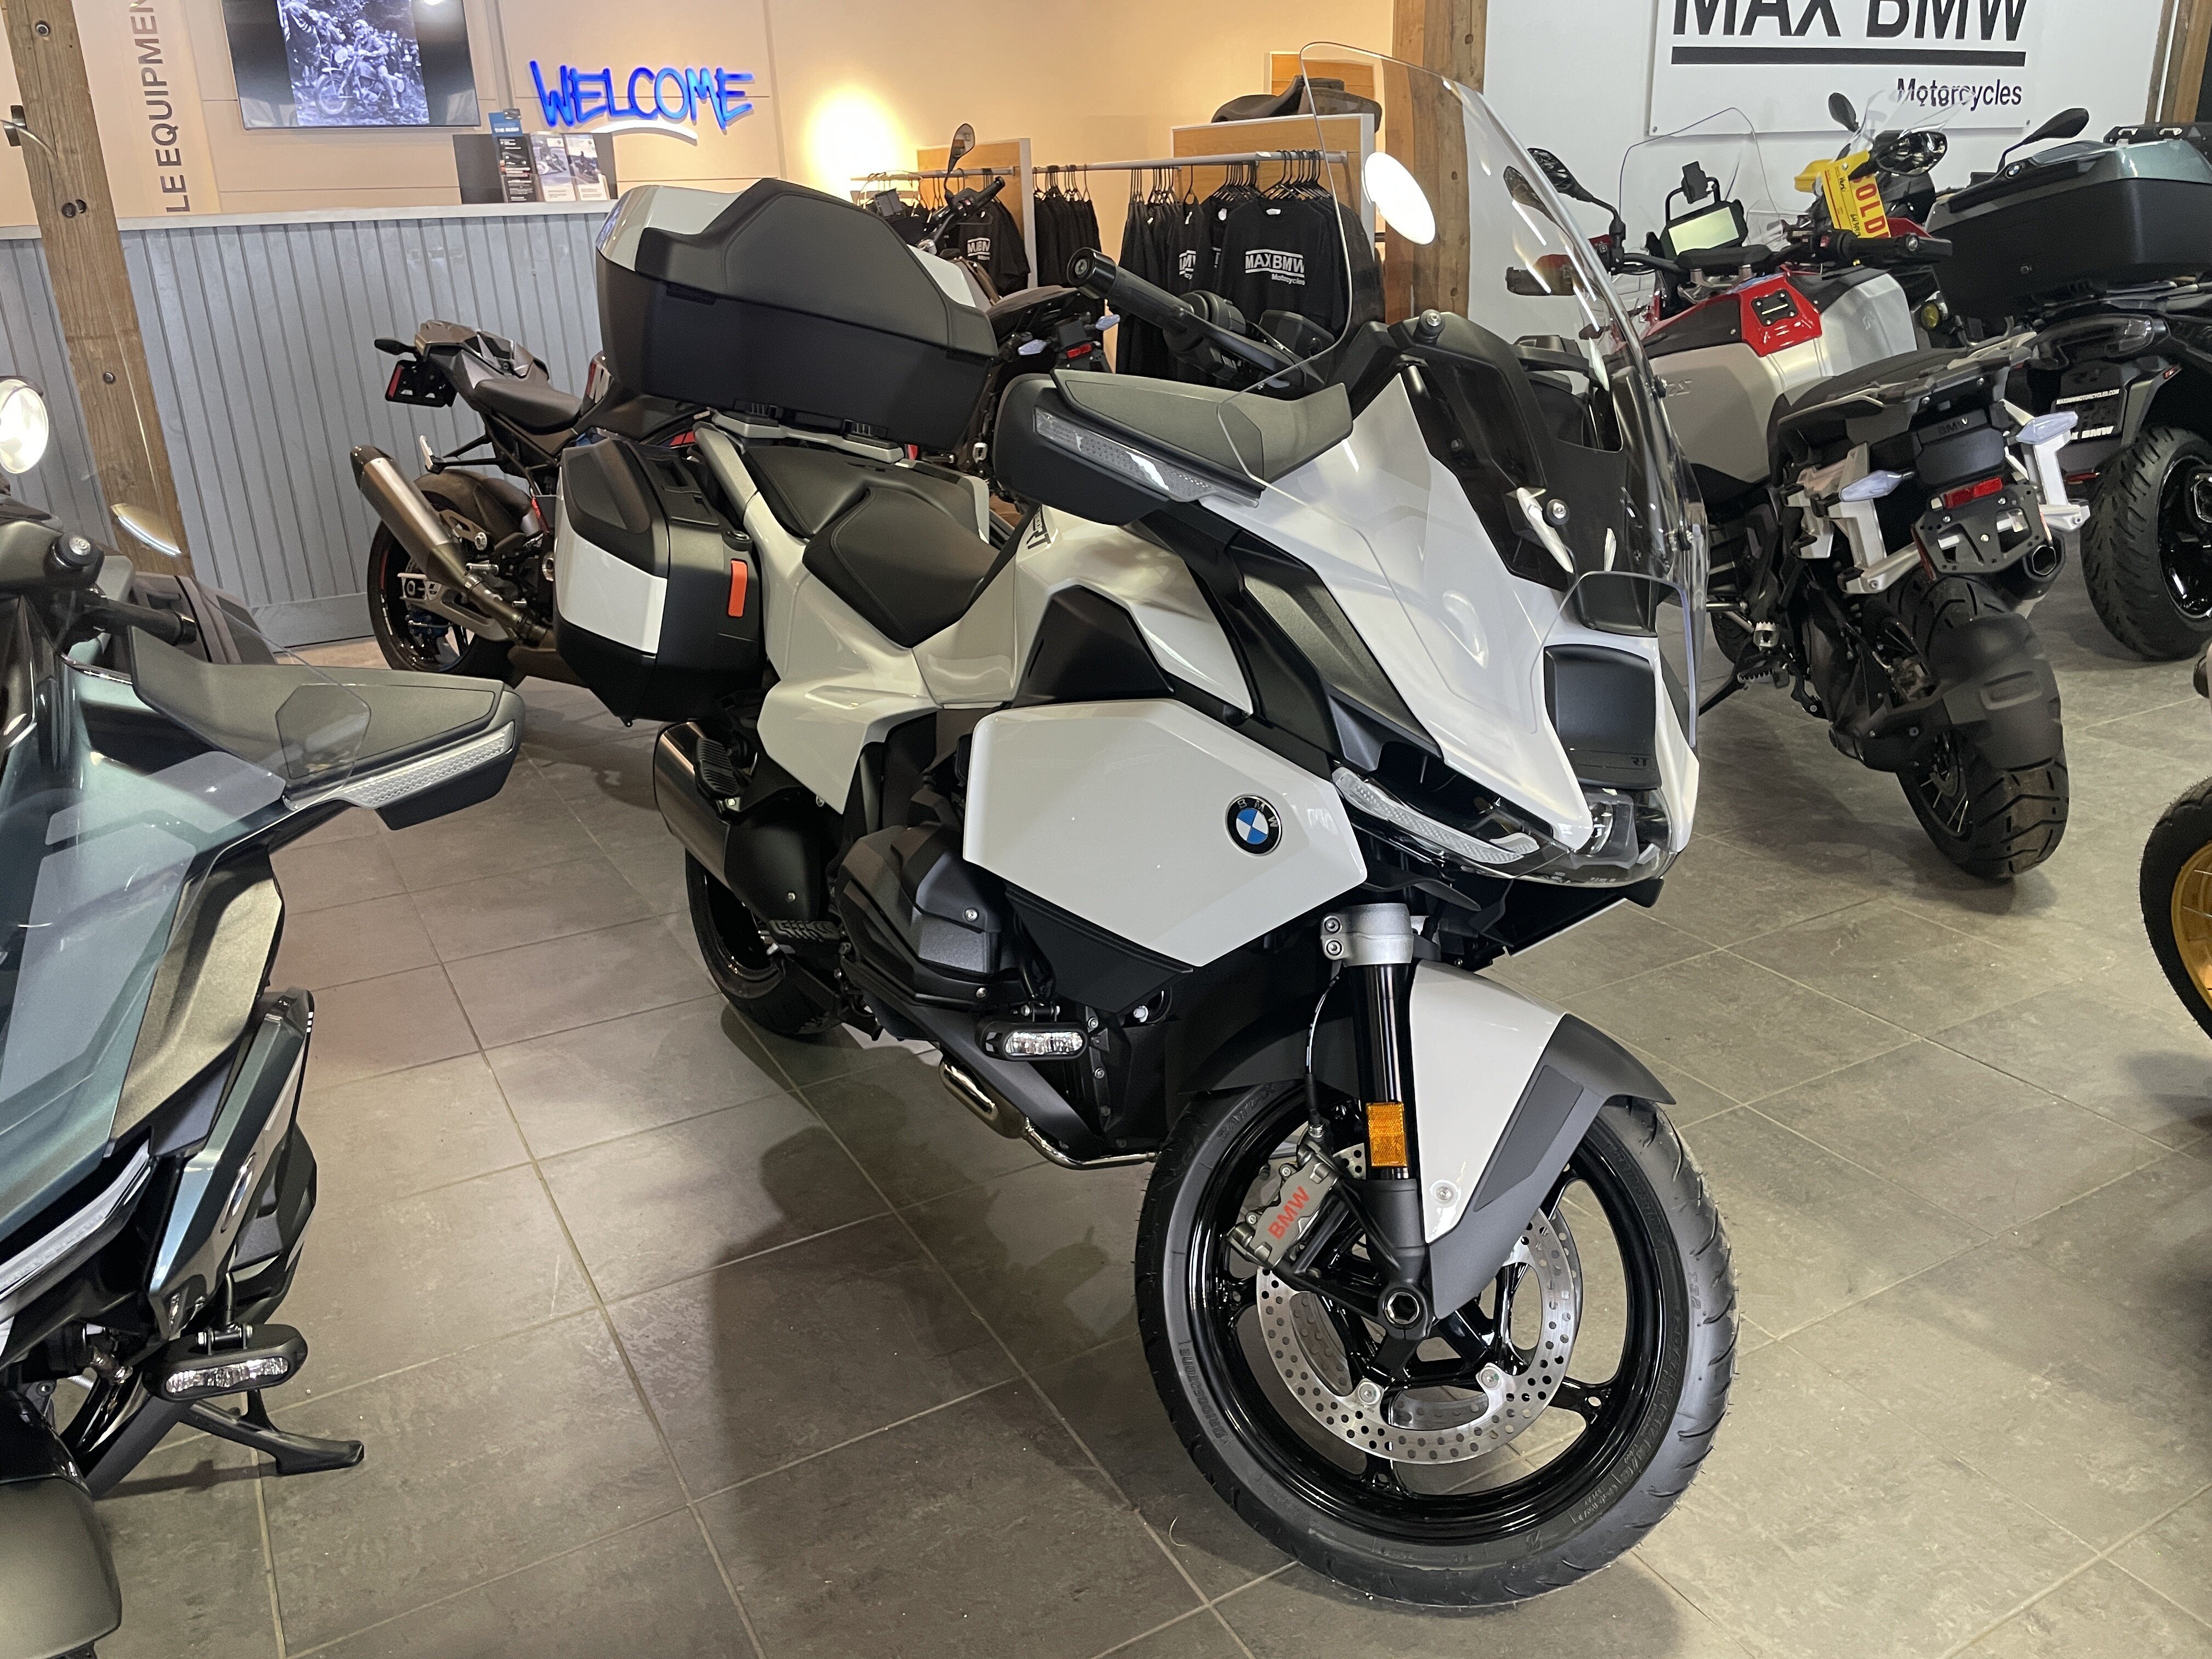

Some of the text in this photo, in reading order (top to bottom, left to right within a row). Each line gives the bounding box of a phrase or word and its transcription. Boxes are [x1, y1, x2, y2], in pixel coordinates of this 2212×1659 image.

[529, 60, 755, 129] WELCOME
[1898, 78, 2022, 111] Motorcycles
[1855, 174, 1890, 238] OLD
[1268, 1186, 1310, 1239] BMW
